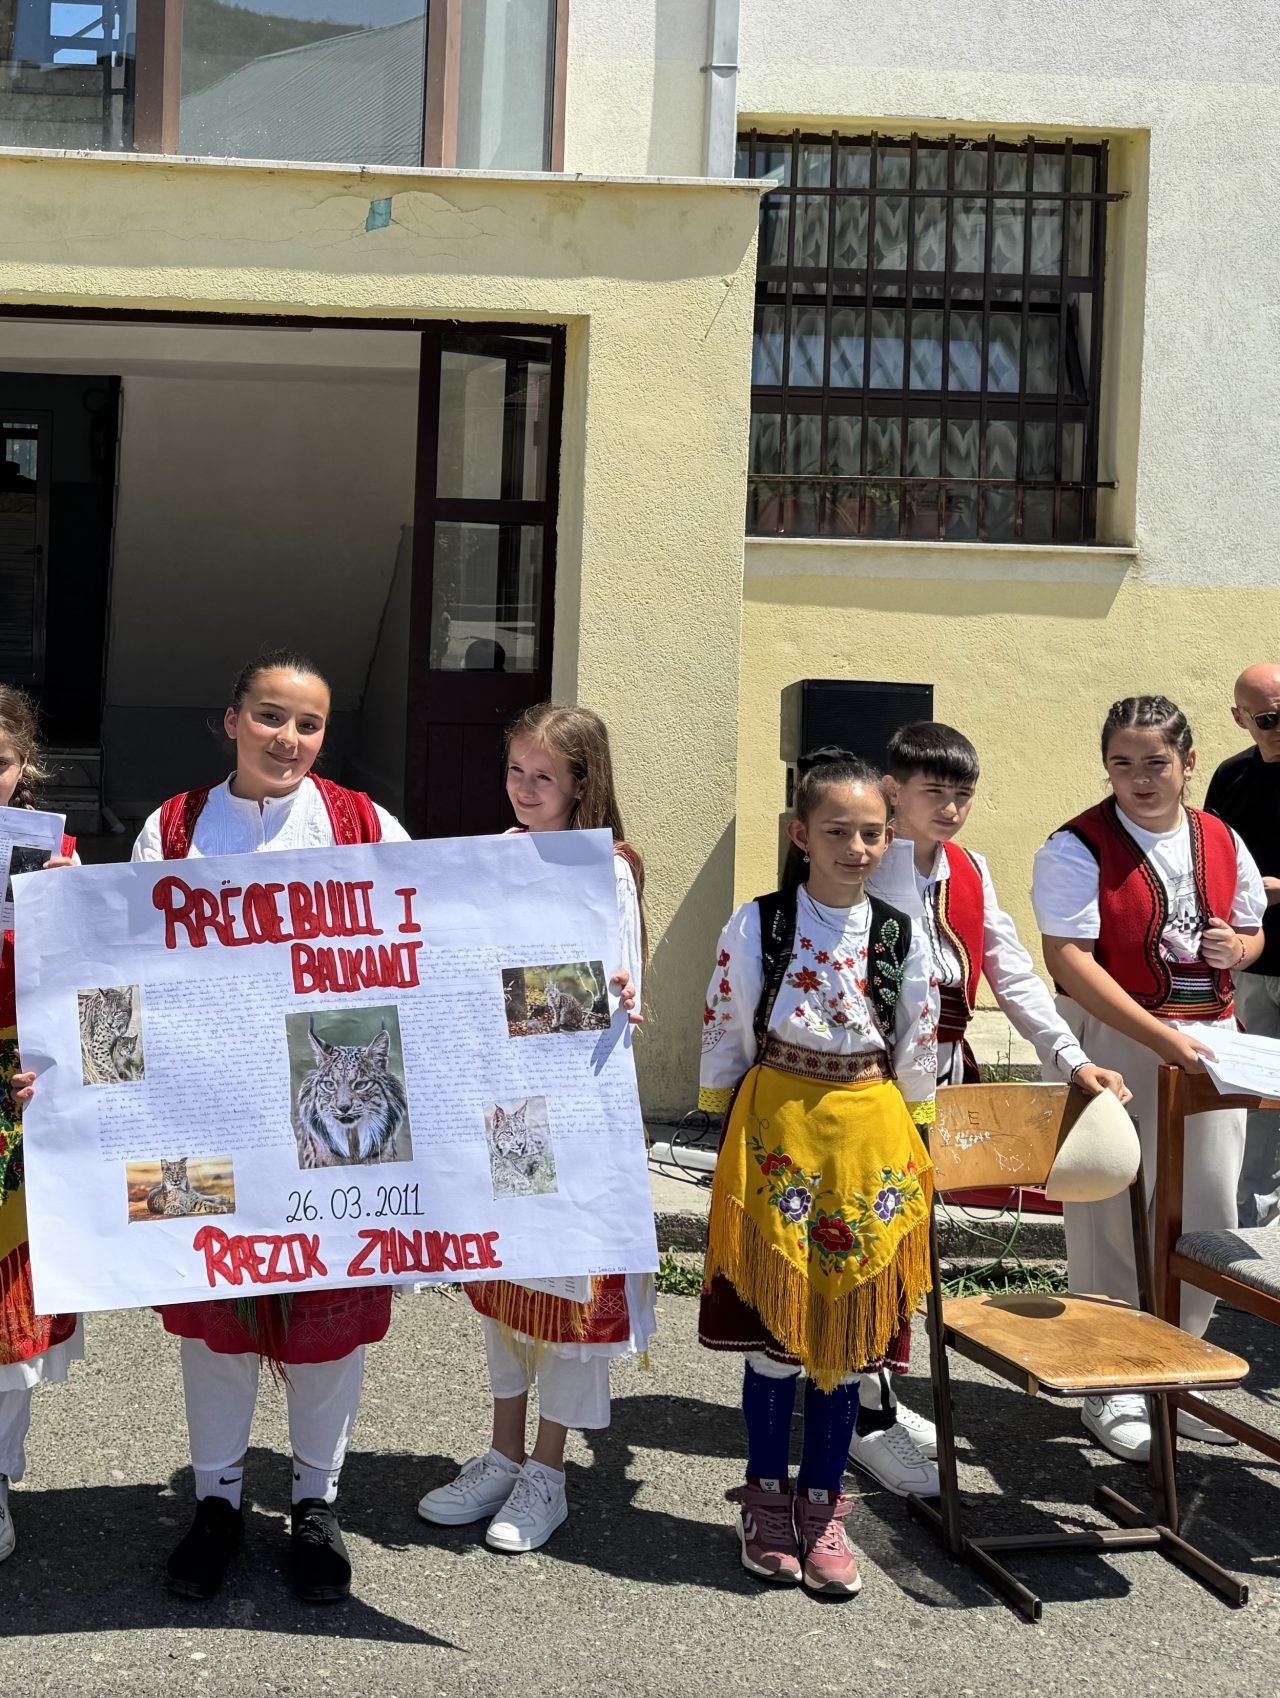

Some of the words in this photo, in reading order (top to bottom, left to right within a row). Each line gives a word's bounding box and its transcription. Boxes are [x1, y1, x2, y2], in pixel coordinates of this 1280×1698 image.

[394, 887, 422, 934] I
[285, 1183, 425, 1223] 26.03.2011
[192, 1224, 329, 1288] RREZIK
